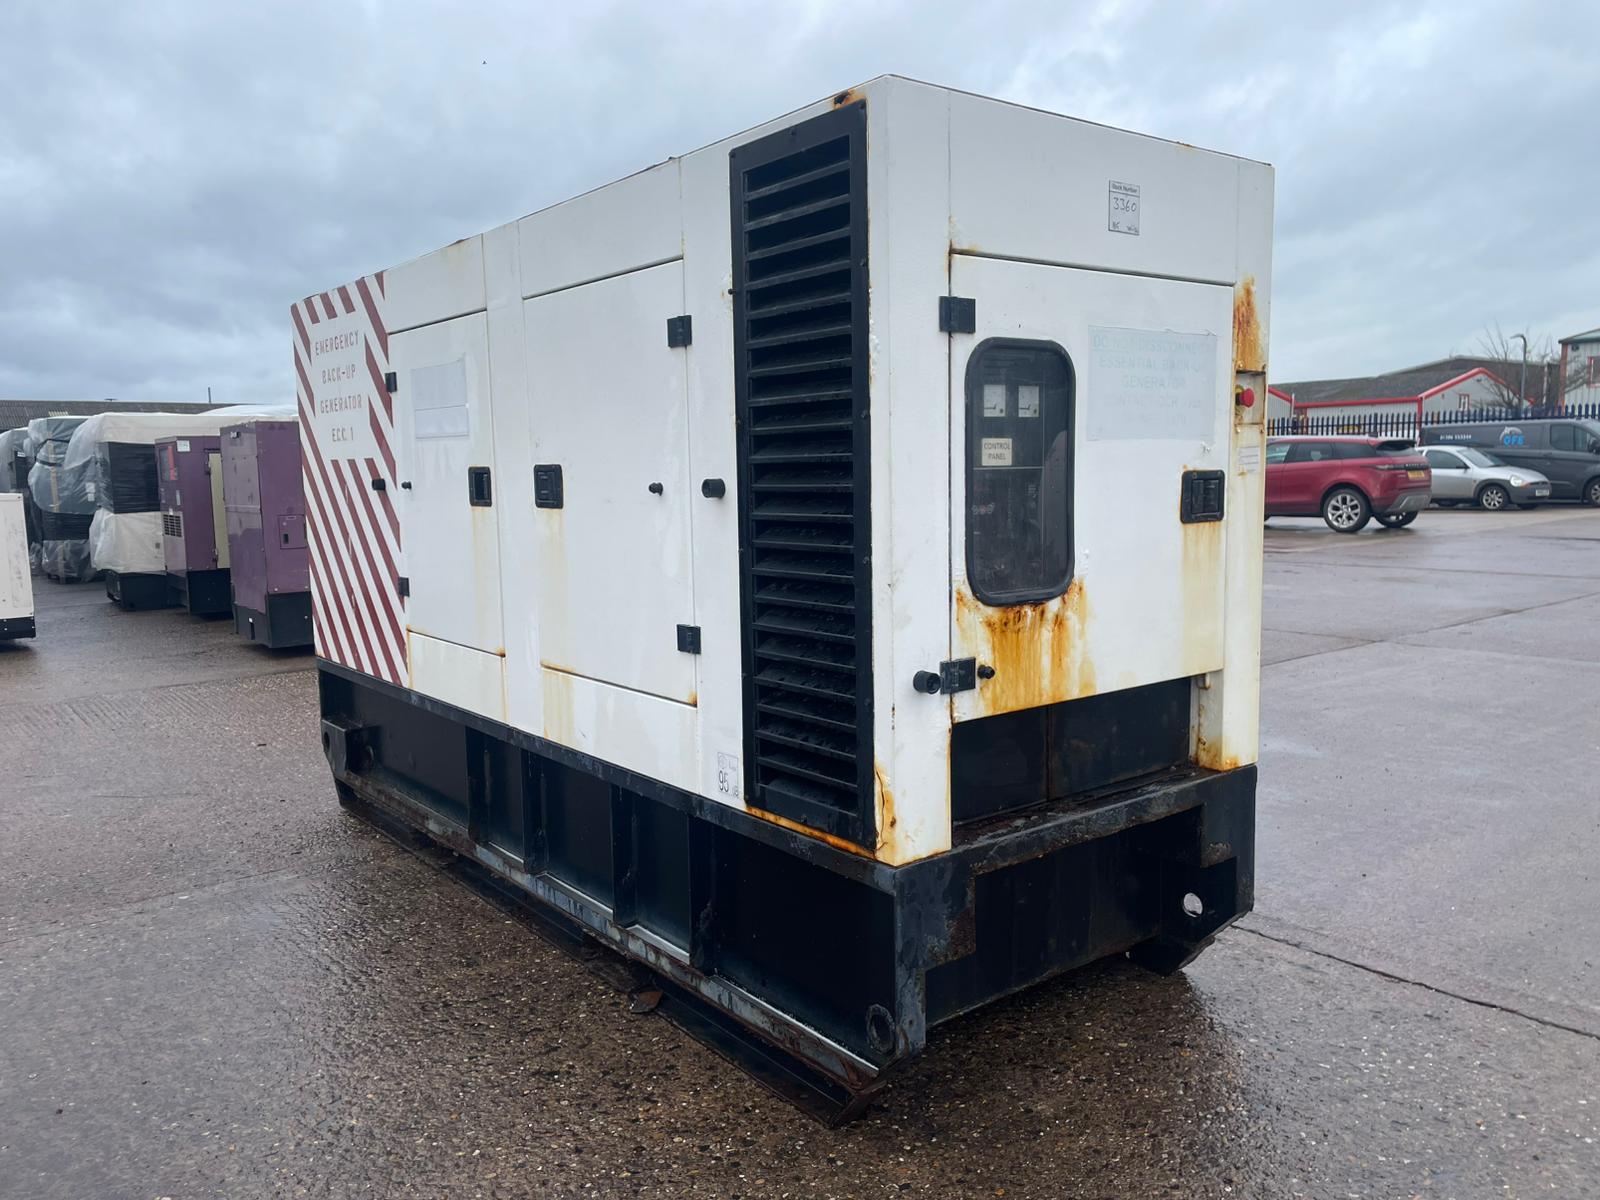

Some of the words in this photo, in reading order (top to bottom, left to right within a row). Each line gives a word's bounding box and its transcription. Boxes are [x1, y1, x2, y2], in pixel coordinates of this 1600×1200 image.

[1113, 197, 1137, 212] 3360
[315, 330, 359, 356] EMERGENCY
[322, 363, 356, 384] BACK-UP
[320, 394, 362, 414] GENERATOR
[983, 442, 1011, 450] CONTROL
